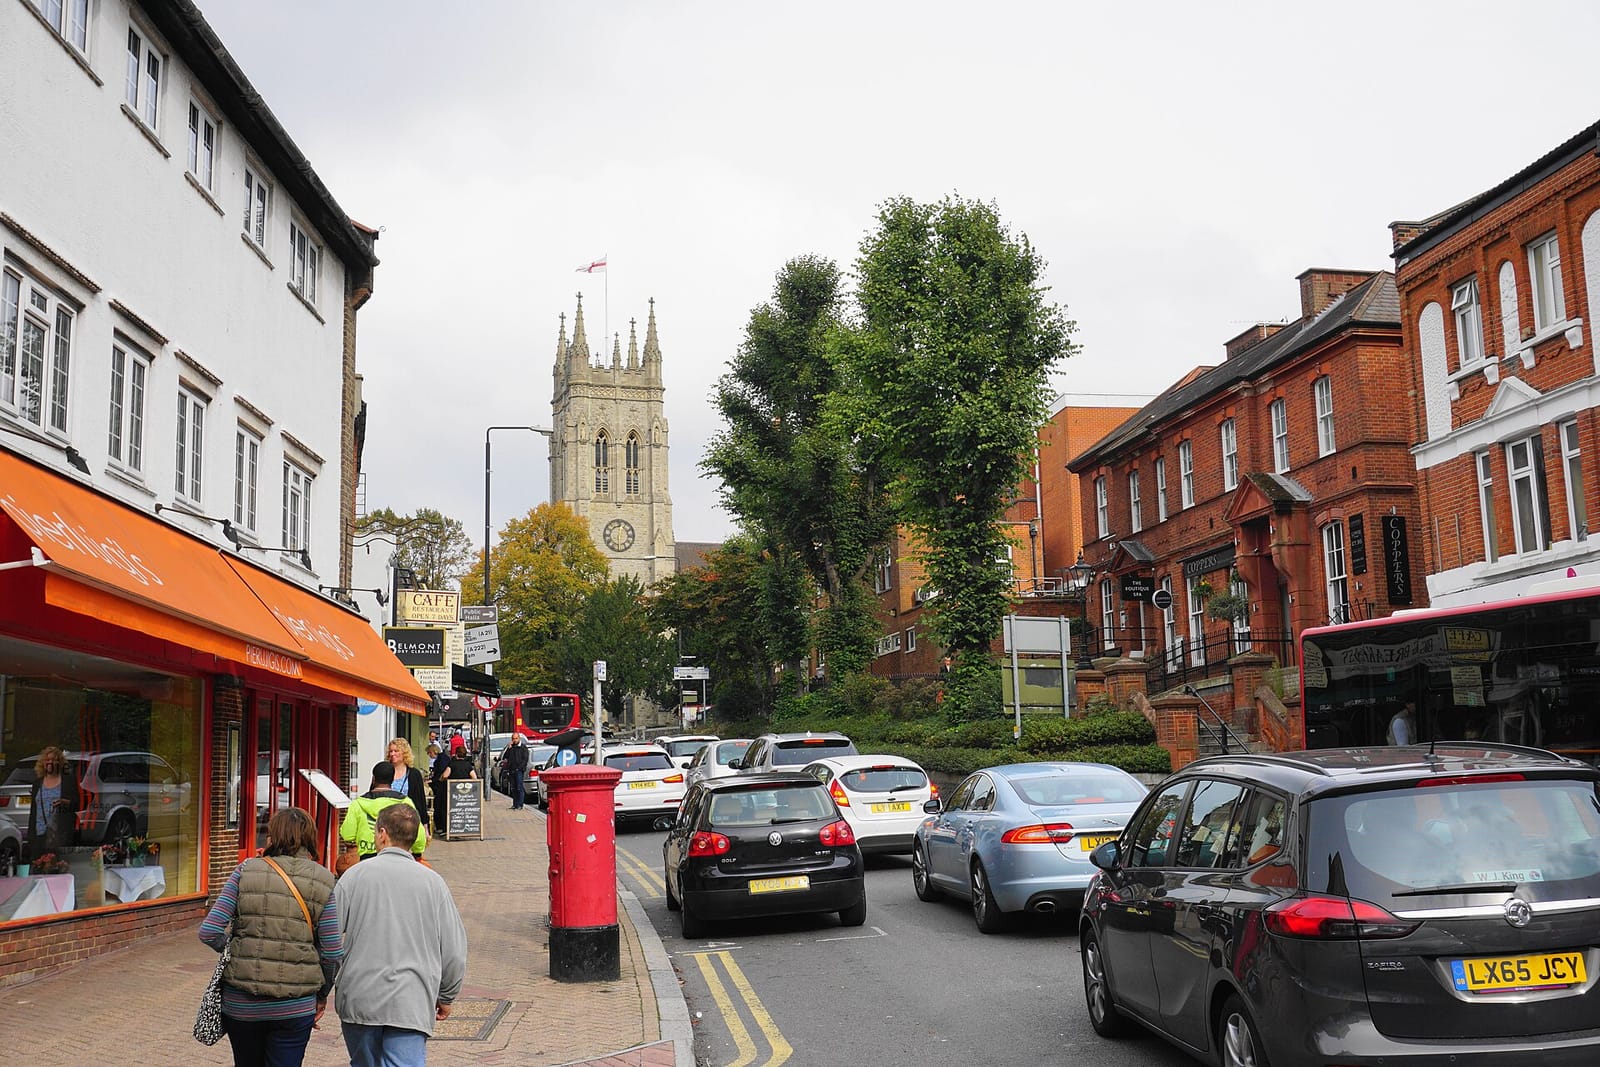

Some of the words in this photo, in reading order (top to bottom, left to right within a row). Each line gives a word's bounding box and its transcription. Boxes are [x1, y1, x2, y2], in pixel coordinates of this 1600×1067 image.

[1186, 554, 1217, 574] COPPERS
[1390, 517, 1404, 595] COPPERS
[413, 594, 454, 607] CAFE
[387, 639, 441, 655] BELMONT
[245, 644, 302, 677] PIERLUIGIS.COM
[541, 697, 553, 706] 354
[1502, 871, 1525, 881] King
[1367, 961, 1402, 969] ZAFIRA
[1468, 959, 1531, 985] LX65
[1538, 956, 1578, 980] JCY
